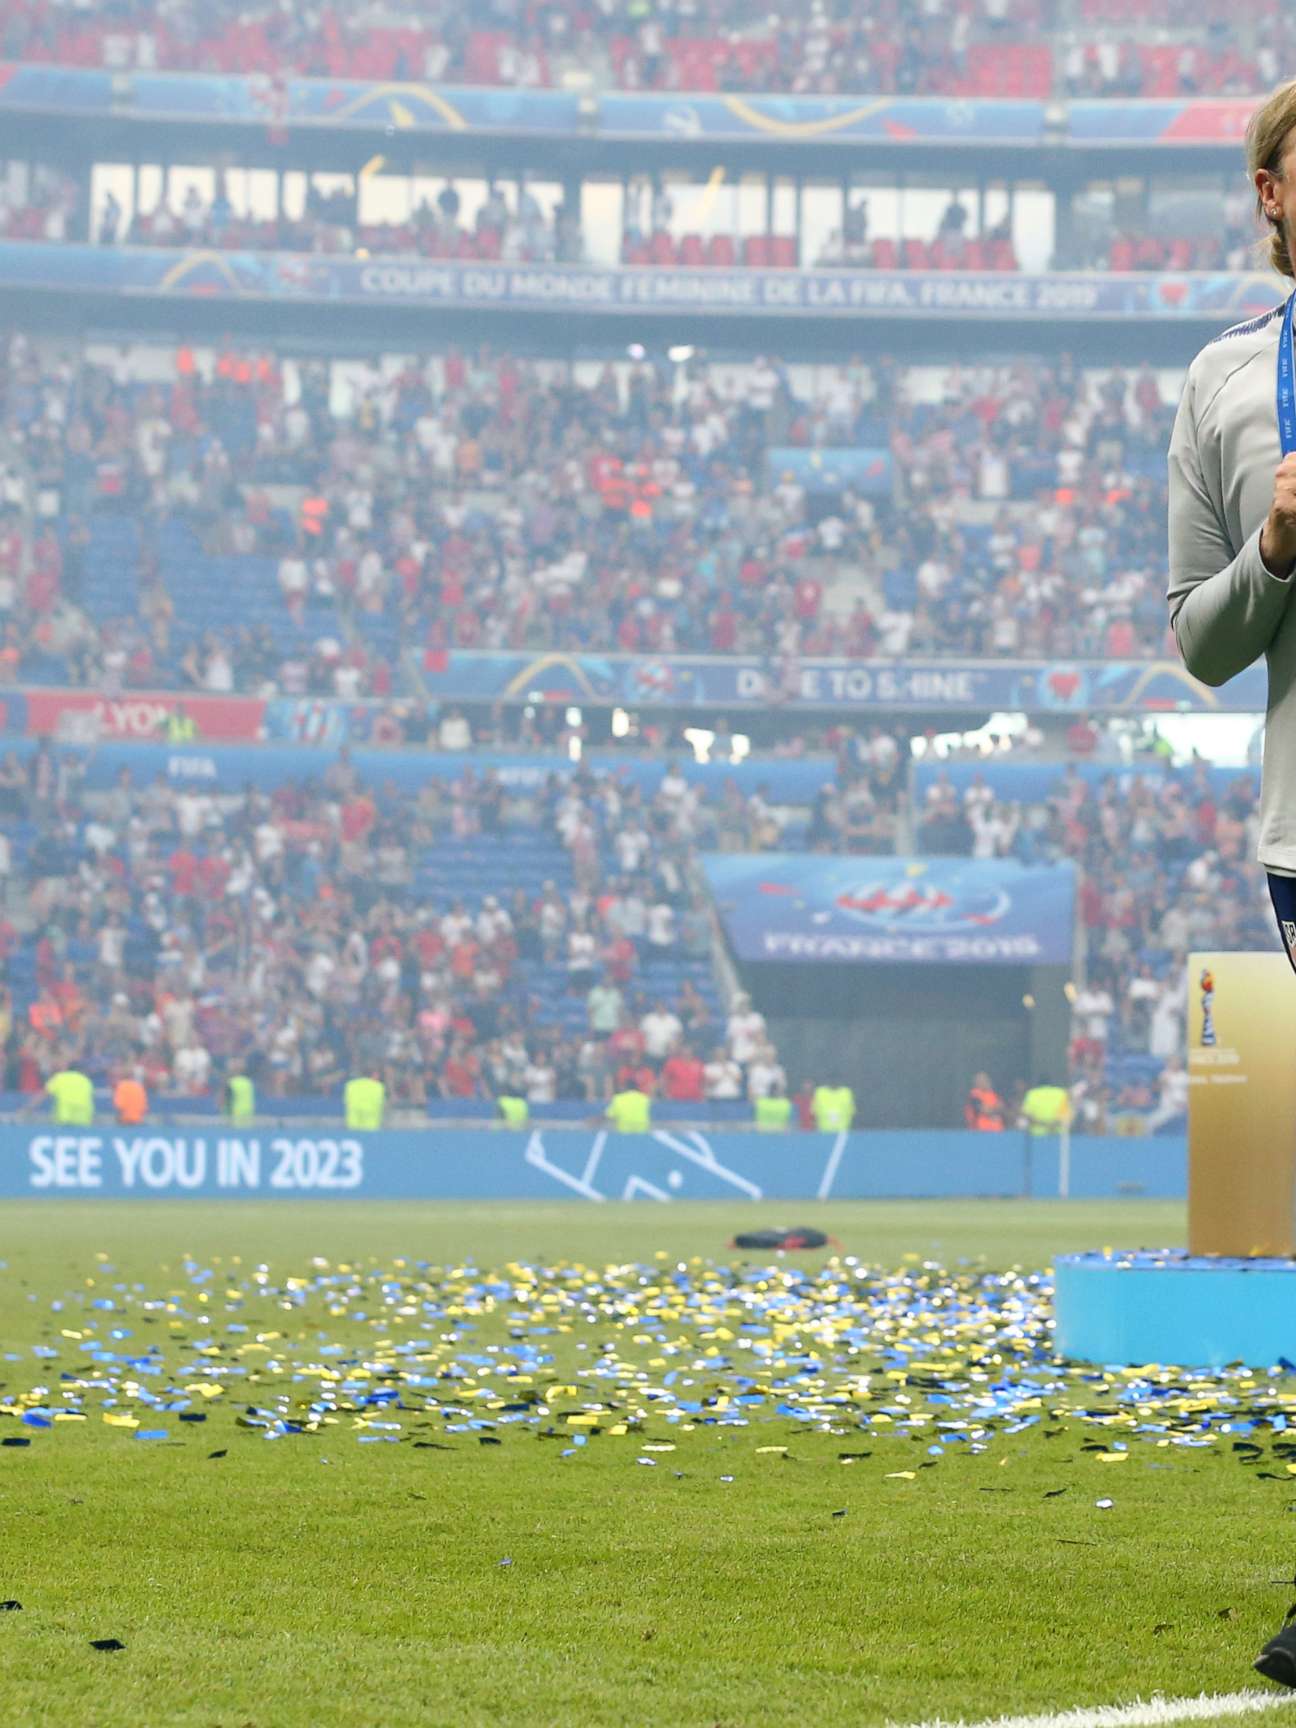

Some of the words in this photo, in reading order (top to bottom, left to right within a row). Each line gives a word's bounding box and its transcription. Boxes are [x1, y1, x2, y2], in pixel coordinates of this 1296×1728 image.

[462, 269, 508, 300] DU
[807, 276, 847, 305] LA
[737, 669, 820, 700] DE
[829, 669, 872, 700] TO
[31, 1137, 102, 1188] SEE
[112, 1137, 206, 1189] YOU
[217, 1138, 260, 1188] IN
[269, 1138, 364, 1189] 2023
